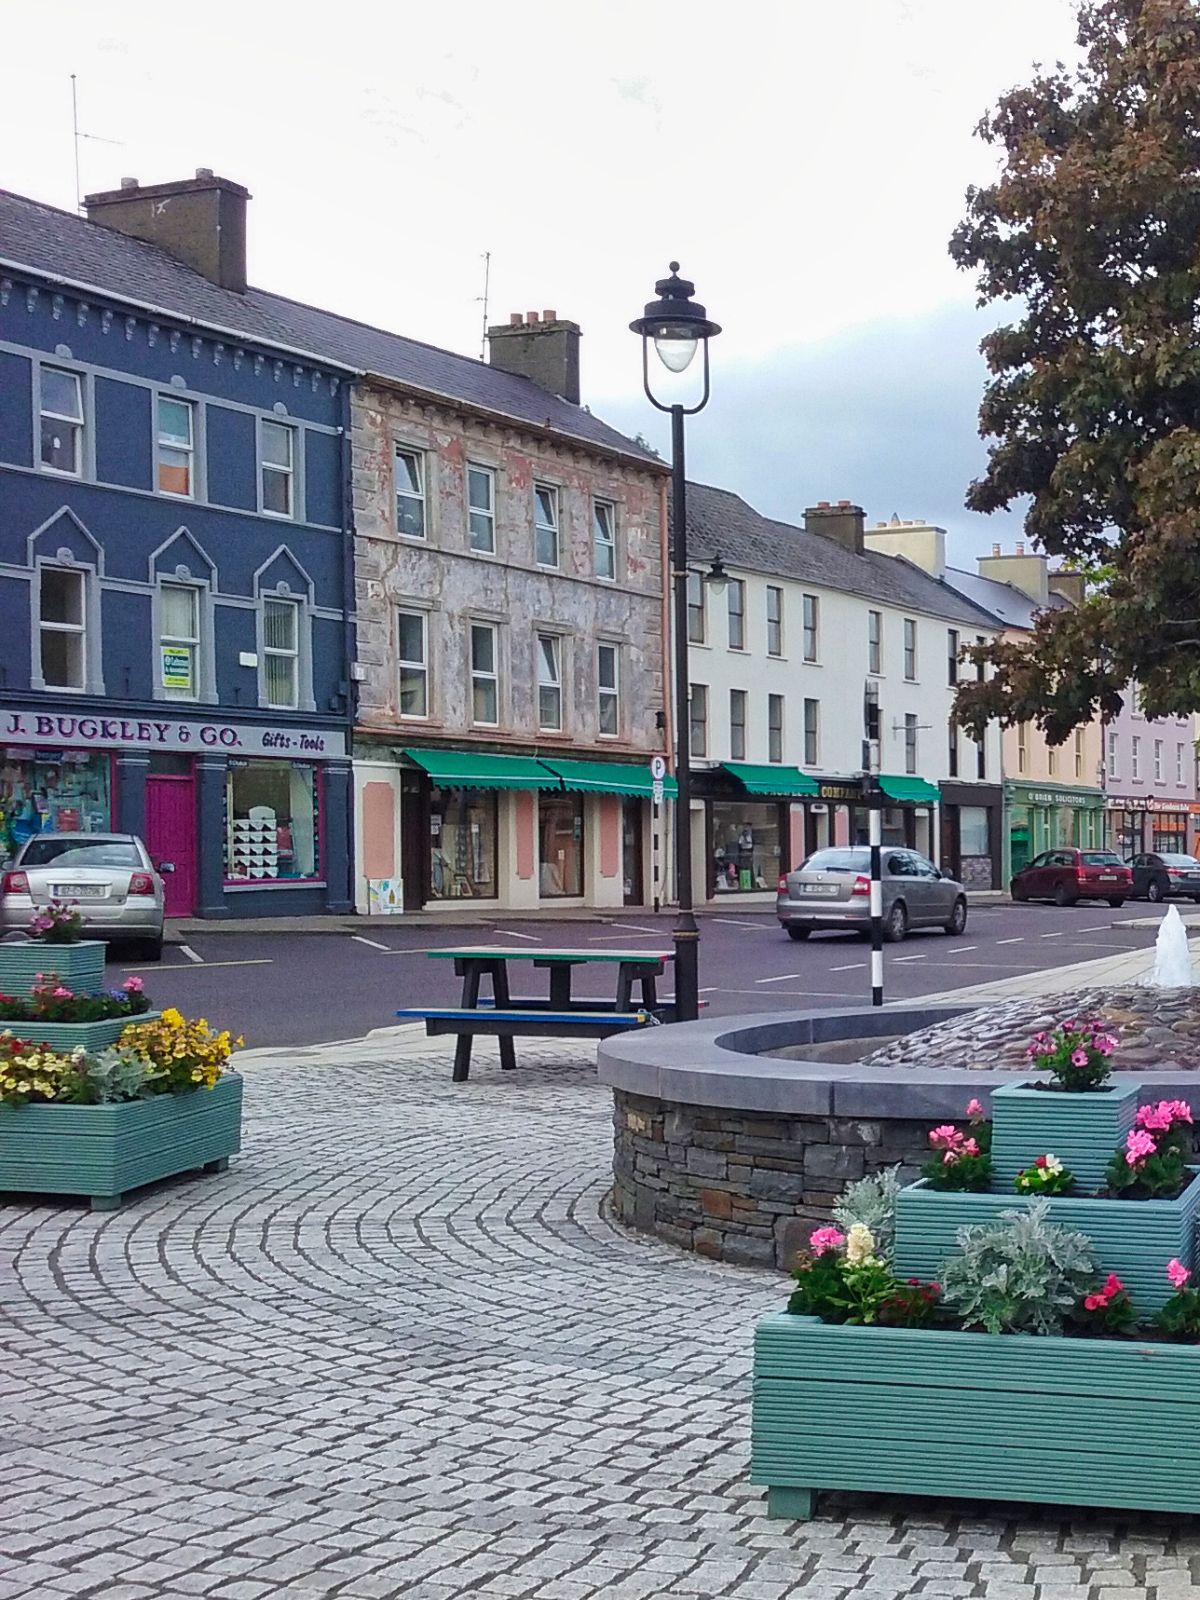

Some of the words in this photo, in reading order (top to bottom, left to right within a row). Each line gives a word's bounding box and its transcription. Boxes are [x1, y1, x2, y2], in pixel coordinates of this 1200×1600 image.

[7, 714, 26, 735] J.
[178, 725, 191, 743] &
[262, 731, 291, 749] Gifts
[299, 734, 325, 752] Tools
[655, 760, 662, 776] P
[1055, 794, 1086, 804] SOLICITORS
